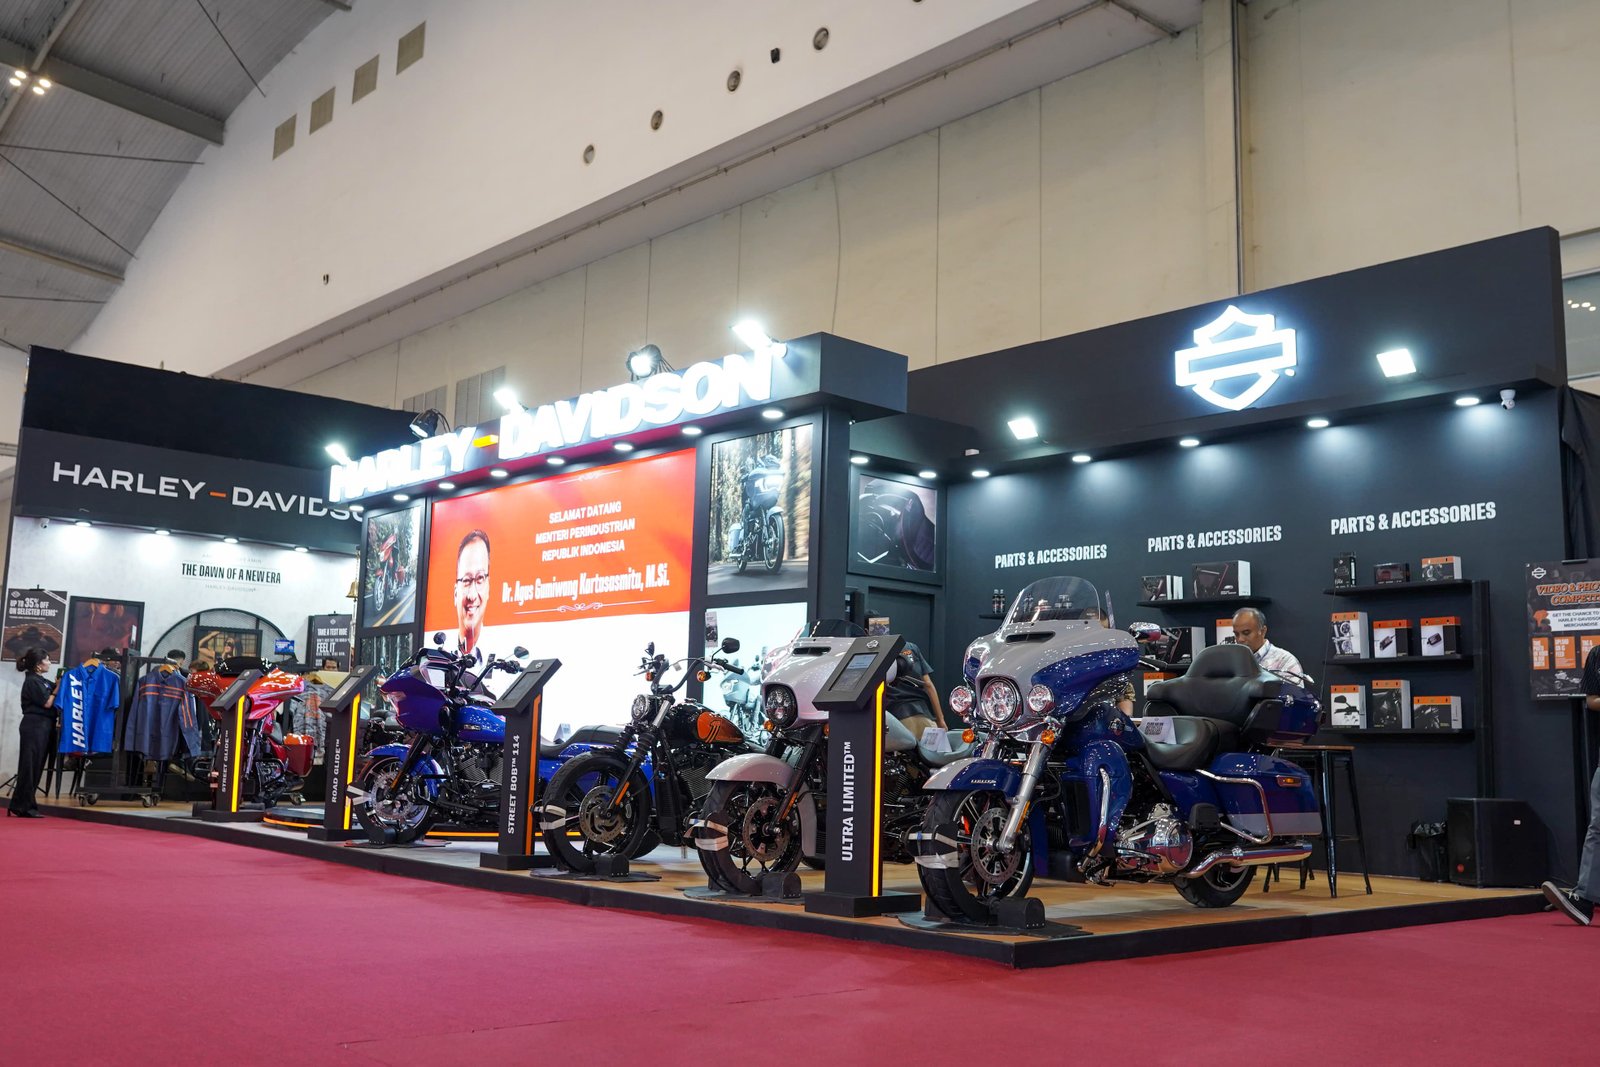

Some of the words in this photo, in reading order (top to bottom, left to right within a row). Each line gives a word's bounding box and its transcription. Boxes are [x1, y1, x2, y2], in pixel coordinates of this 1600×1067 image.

[52, 461, 362, 522] HARLEY-DAVIDS
[549, 507, 587, 524] SELAMAT
[587, 501, 621, 518] DATANG
[1331, 515, 1375, 535] PARTS
[1378, 514, 1389, 530] &
[1391, 501, 1497, 529] ACCESSORIES
[535, 531, 569, 544] MENTERI
[570, 518, 635, 538] PERINDUSTRIAN
[1148, 534, 1185, 552] PARTS
[1187, 533, 1196, 548] &
[1197, 525, 1282, 547] ACCESSORIES
[542, 546, 579, 561] REPUBLIK
[580, 540, 625, 557] INDONESIA
[995, 553, 1026, 569] PARTS
[1027, 550, 1036, 565] &
[1037, 544, 1107, 564] ACCESSORIES
[182, 563, 198, 577] THE
[199, 565, 225, 579] DAWN
[226, 568, 237, 580] OF
[238, 569, 244, 580] A
[245, 570, 265, 582] NEW
[266, 571, 281, 584] ERA
[514, 580, 534, 606] Agus
[645, 563, 670, 588] M.Si.
[1536, 583, 1568, 595] VIDEO
[1576, 581, 1600, 593] PHO
[17, 608, 40, 616] SELECTED
[25, 597, 40, 608] 35%
[40, 601, 49, 609] OFF
[316, 642, 329, 653] FEEL
[329, 642, 336, 653] IT
[69, 674, 86, 748] HARLEY
[331, 777, 339, 803] ROAD
[508, 794, 516, 834] STREET
[512, 735, 520, 756] 114
[842, 816, 853, 861] ULTRA
